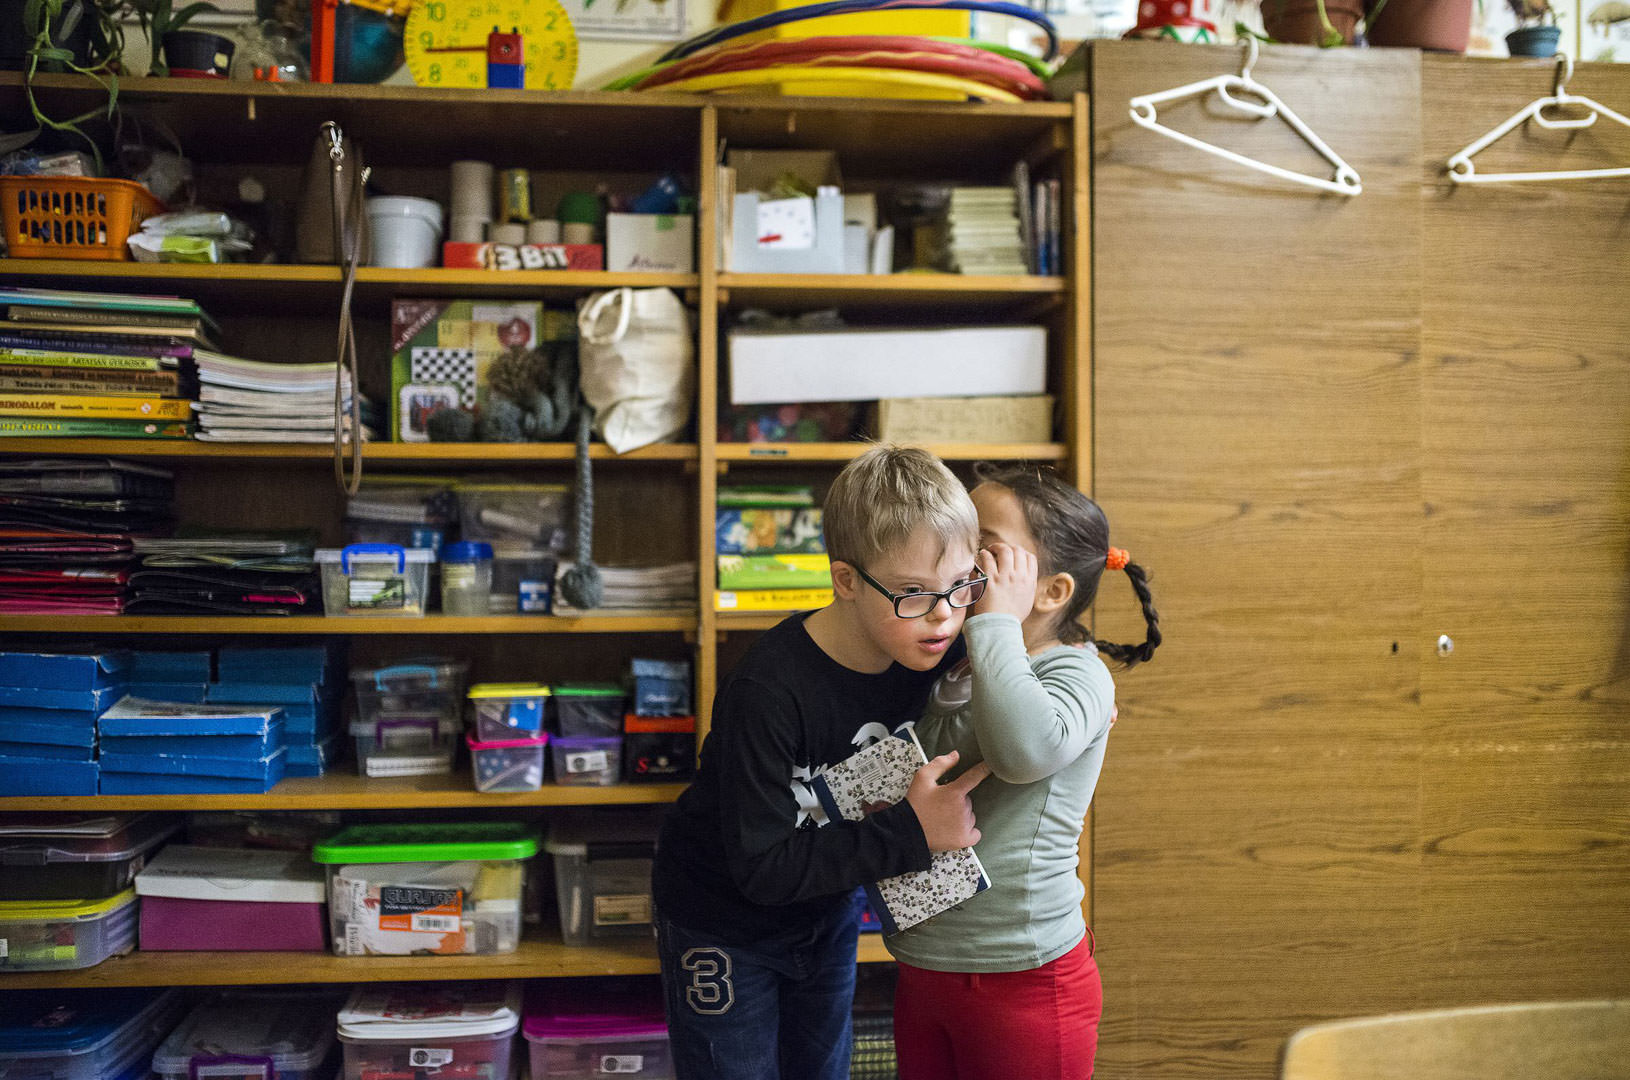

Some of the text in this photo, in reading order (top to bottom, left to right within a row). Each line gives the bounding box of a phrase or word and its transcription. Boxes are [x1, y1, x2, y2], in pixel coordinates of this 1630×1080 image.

[427, 2, 446, 22] 10
[545, 11, 557, 31] 2
[429, 63, 441, 83] 8
[681, 947, 735, 1015] 3
